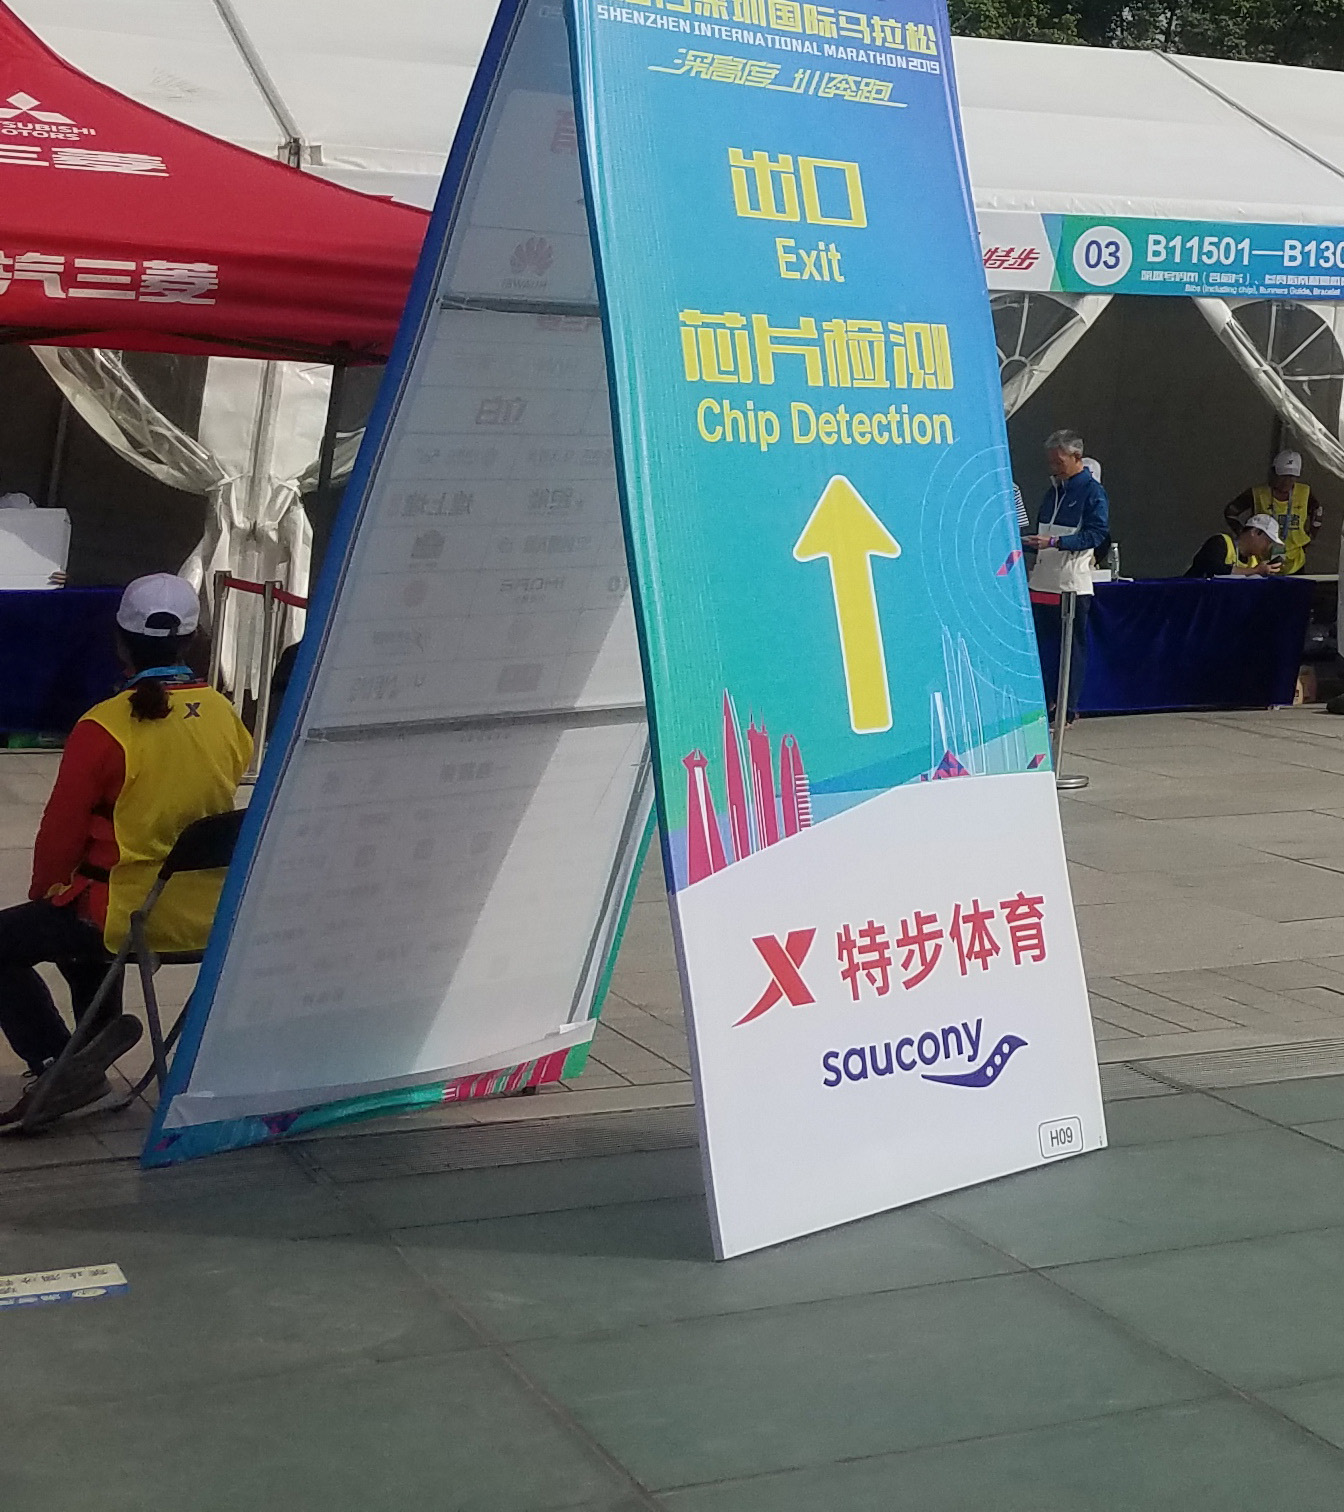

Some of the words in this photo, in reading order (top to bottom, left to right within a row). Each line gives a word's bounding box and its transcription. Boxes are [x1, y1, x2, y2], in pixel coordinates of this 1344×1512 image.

[597, 5, 690, 34] SHENZHEN
[693, 19, 822, 56] INTERNATIONAL
[824, 44, 907, 70] MARATHON
[908, 55, 940, 75] 2019
[0, 121, 97, 136] SUBISHI
[727, 147, 867, 228] 出口
[775, 236, 845, 284] Exit
[1084, 239, 1121, 271] 03
[679, 309, 954, 390] 芯片检测
[697, 398, 780, 452] Chip
[791, 402, 954, 446] Detection
[834, 891, 1048, 1002] 特步体育
[822, 1017, 984, 1088] saucony
[1050, 1126, 1074, 1148] H09
